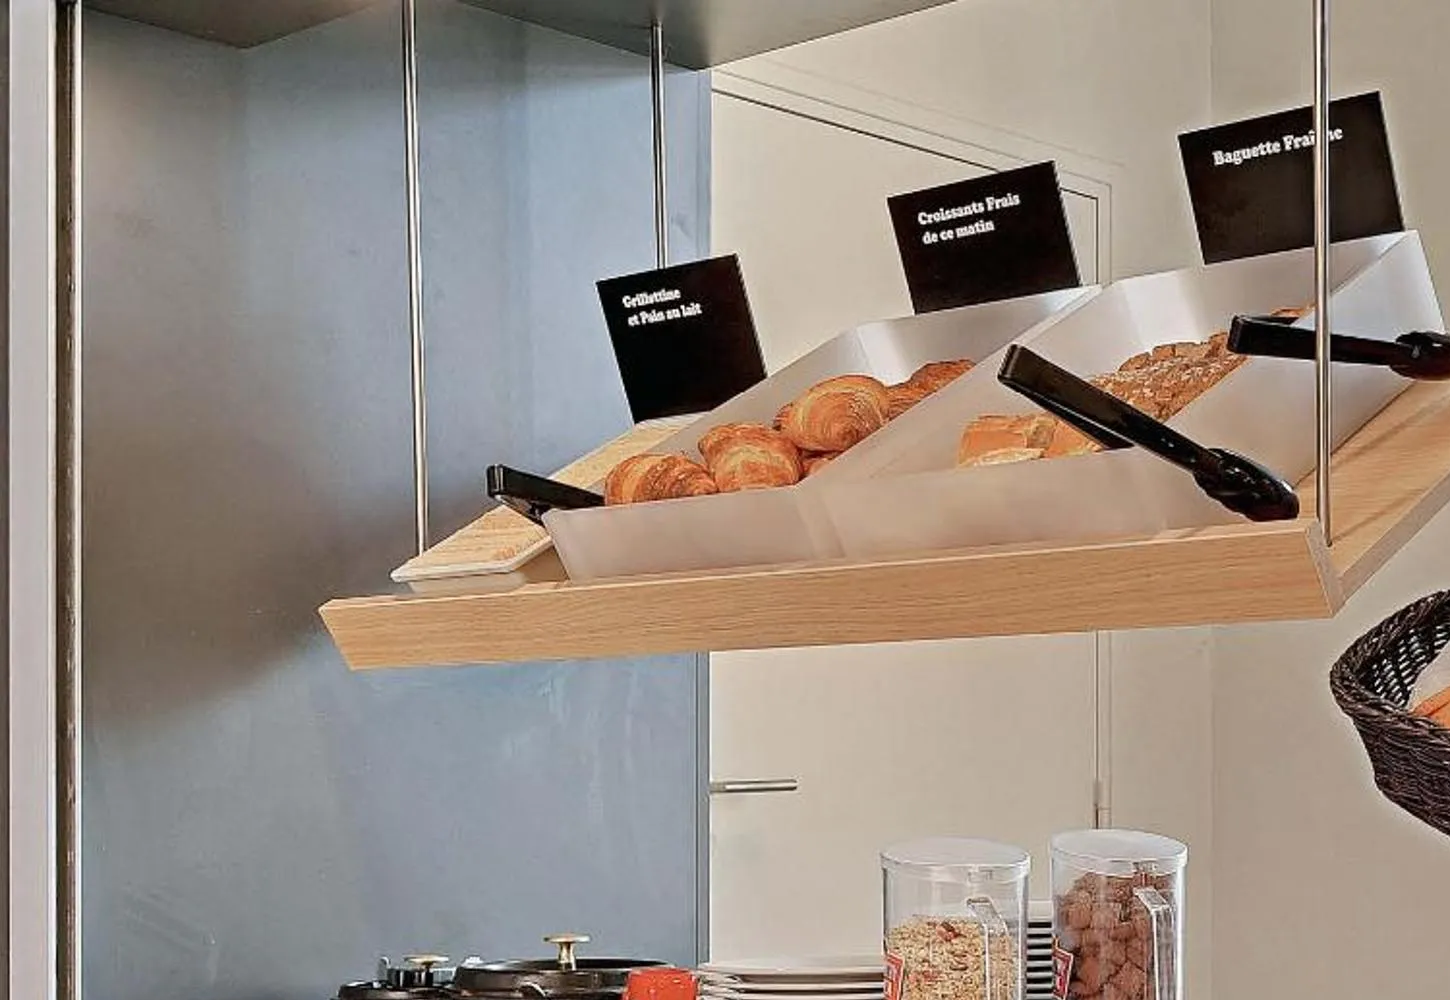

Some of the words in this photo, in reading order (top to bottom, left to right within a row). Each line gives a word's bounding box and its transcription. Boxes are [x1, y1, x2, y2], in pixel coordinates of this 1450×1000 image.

[1212, 141, 1281, 165] Baguette
[1282, 128, 1343, 152] Fraîe
[918, 201, 984, 225] Croissants
[985, 193, 1021, 211] Frais
[922, 231, 938, 245] de
[939, 229, 954, 241] ce
[955, 220, 995, 238] matin
